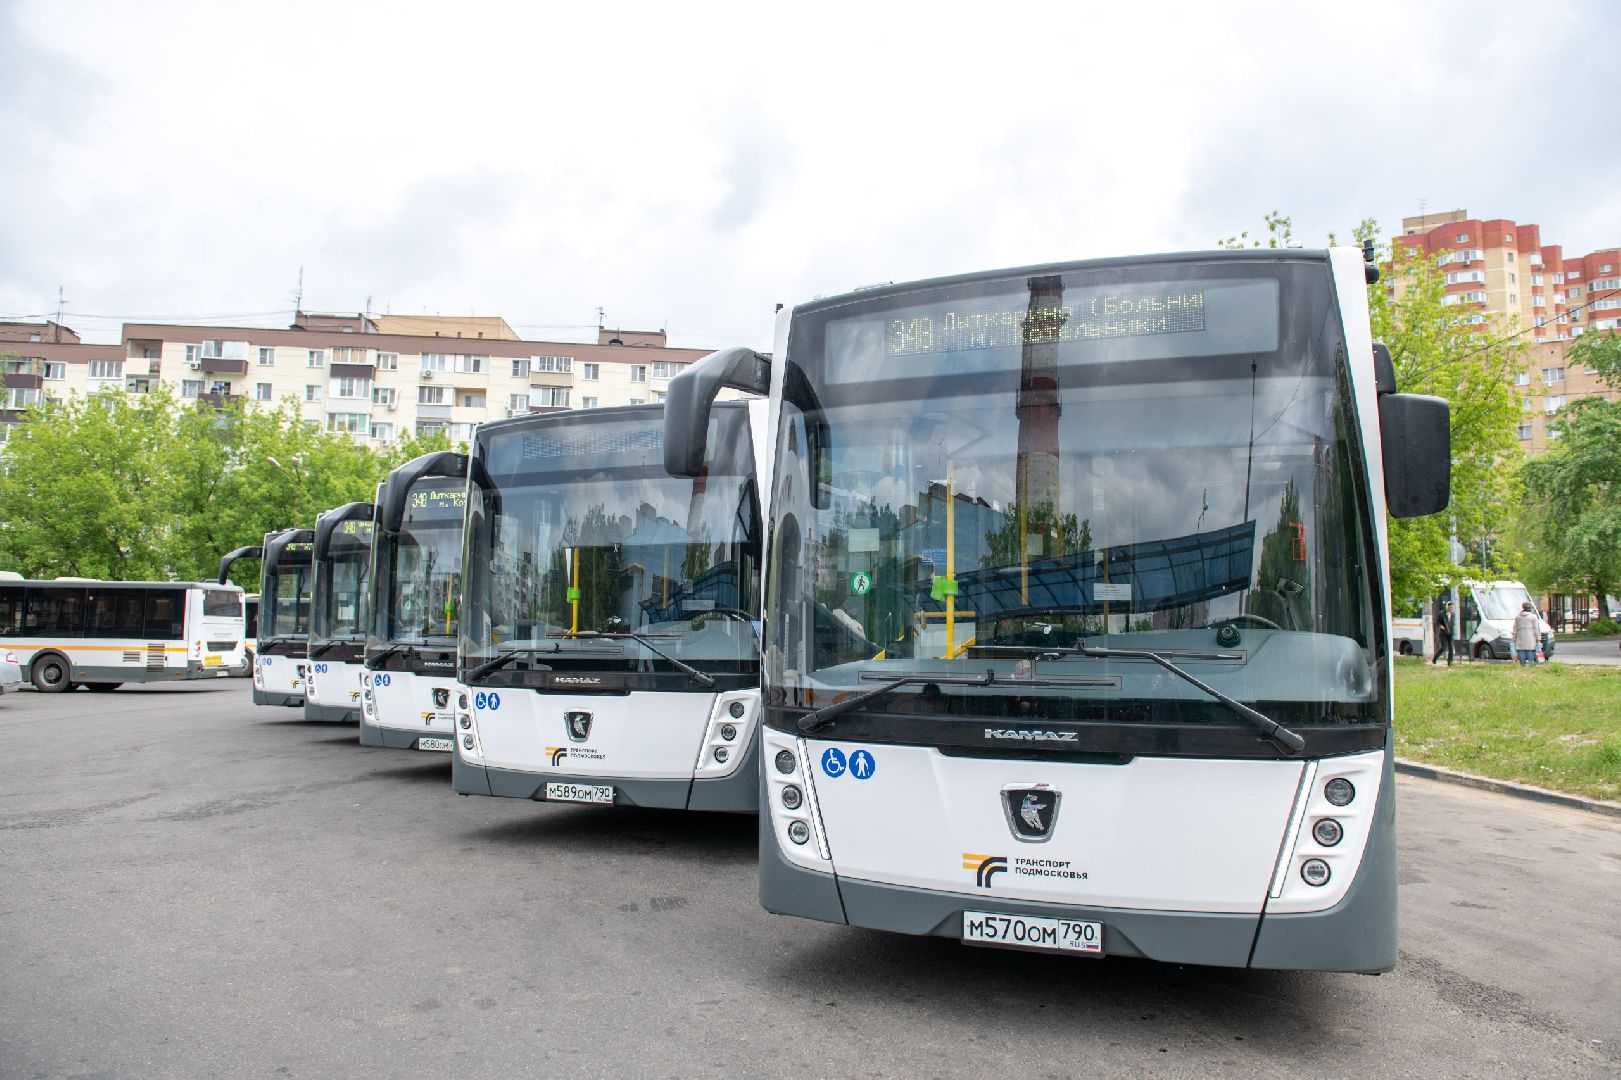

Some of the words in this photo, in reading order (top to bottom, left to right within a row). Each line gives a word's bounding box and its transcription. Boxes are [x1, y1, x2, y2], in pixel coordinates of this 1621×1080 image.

[984, 728, 1079, 742] KAMAZ
[1015, 858, 1071, 869] ТРАНСПОРТ
[1015, 867, 1088, 880] ПОДМОСКОВЬЯ
[1060, 922, 1095, 941] 790
[1070, 940, 1087, 949] RUS
